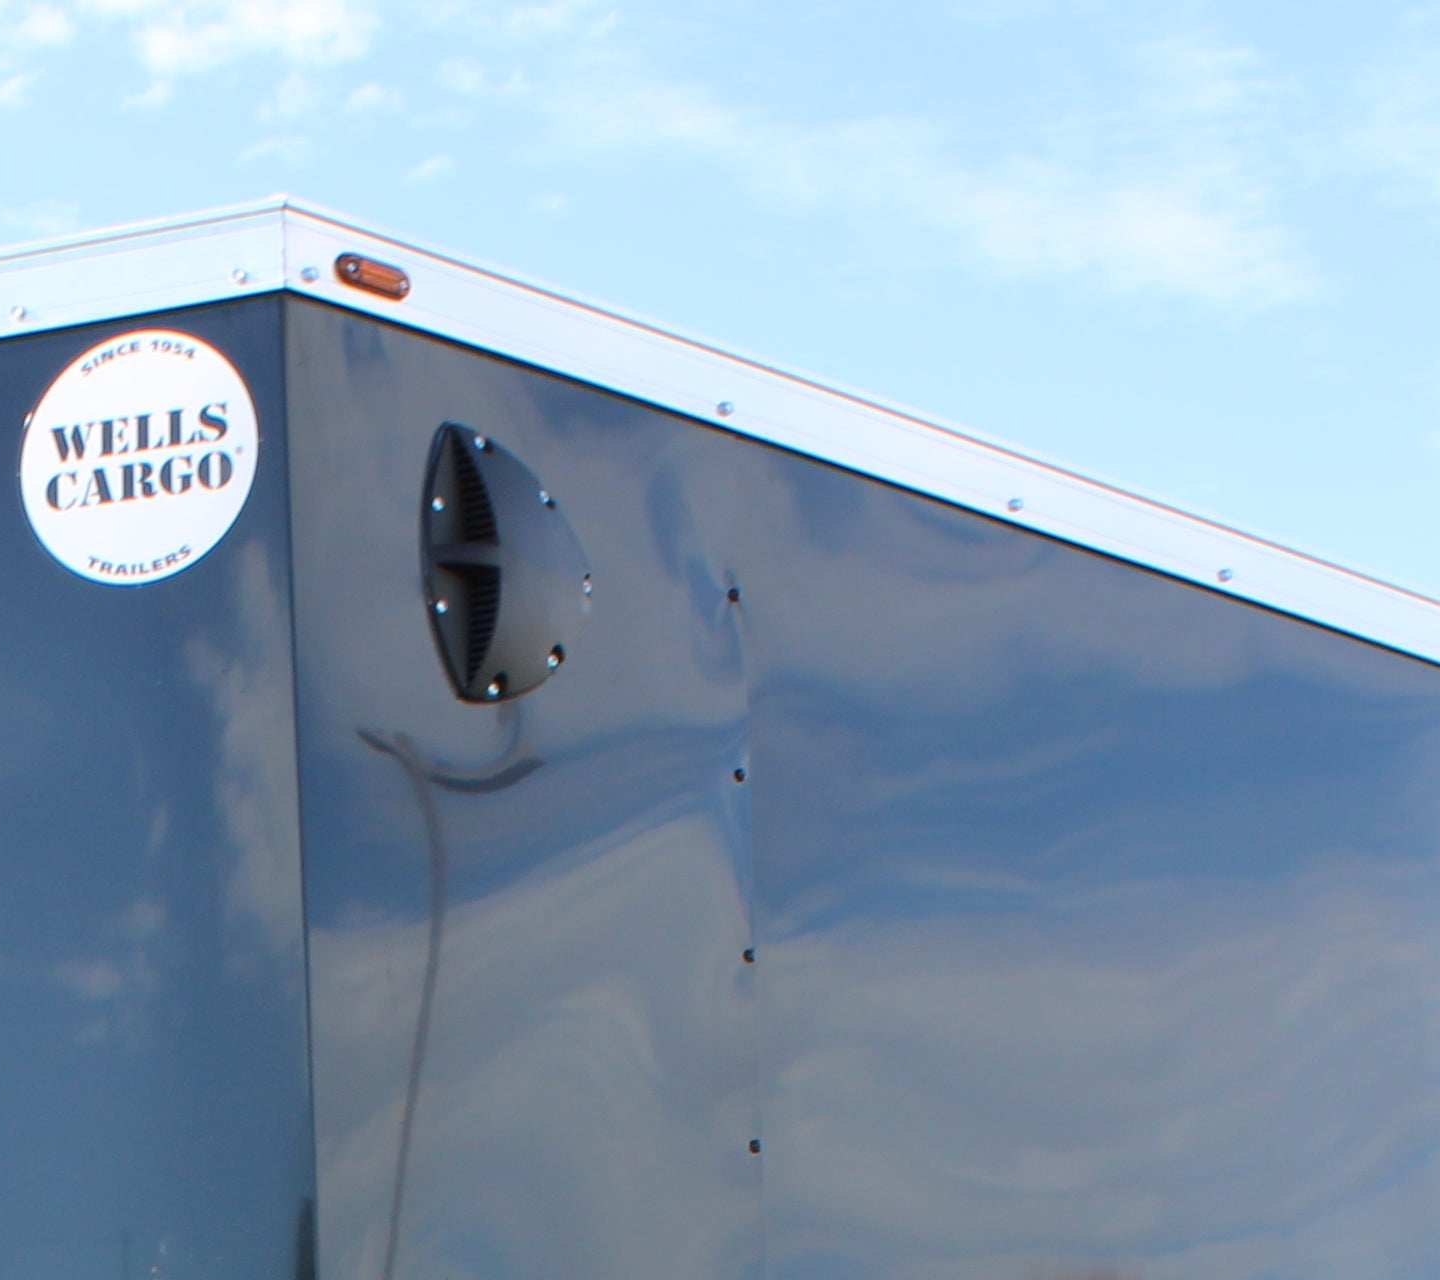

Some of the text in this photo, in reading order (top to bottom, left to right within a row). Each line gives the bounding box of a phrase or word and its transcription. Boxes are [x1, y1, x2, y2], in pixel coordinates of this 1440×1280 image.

[80, 338, 197, 377] SINCE 1954
[48, 401, 230, 464] WELLS
[45, 450, 234, 512] CARGO
[86, 543, 193, 577] TRAILERS
